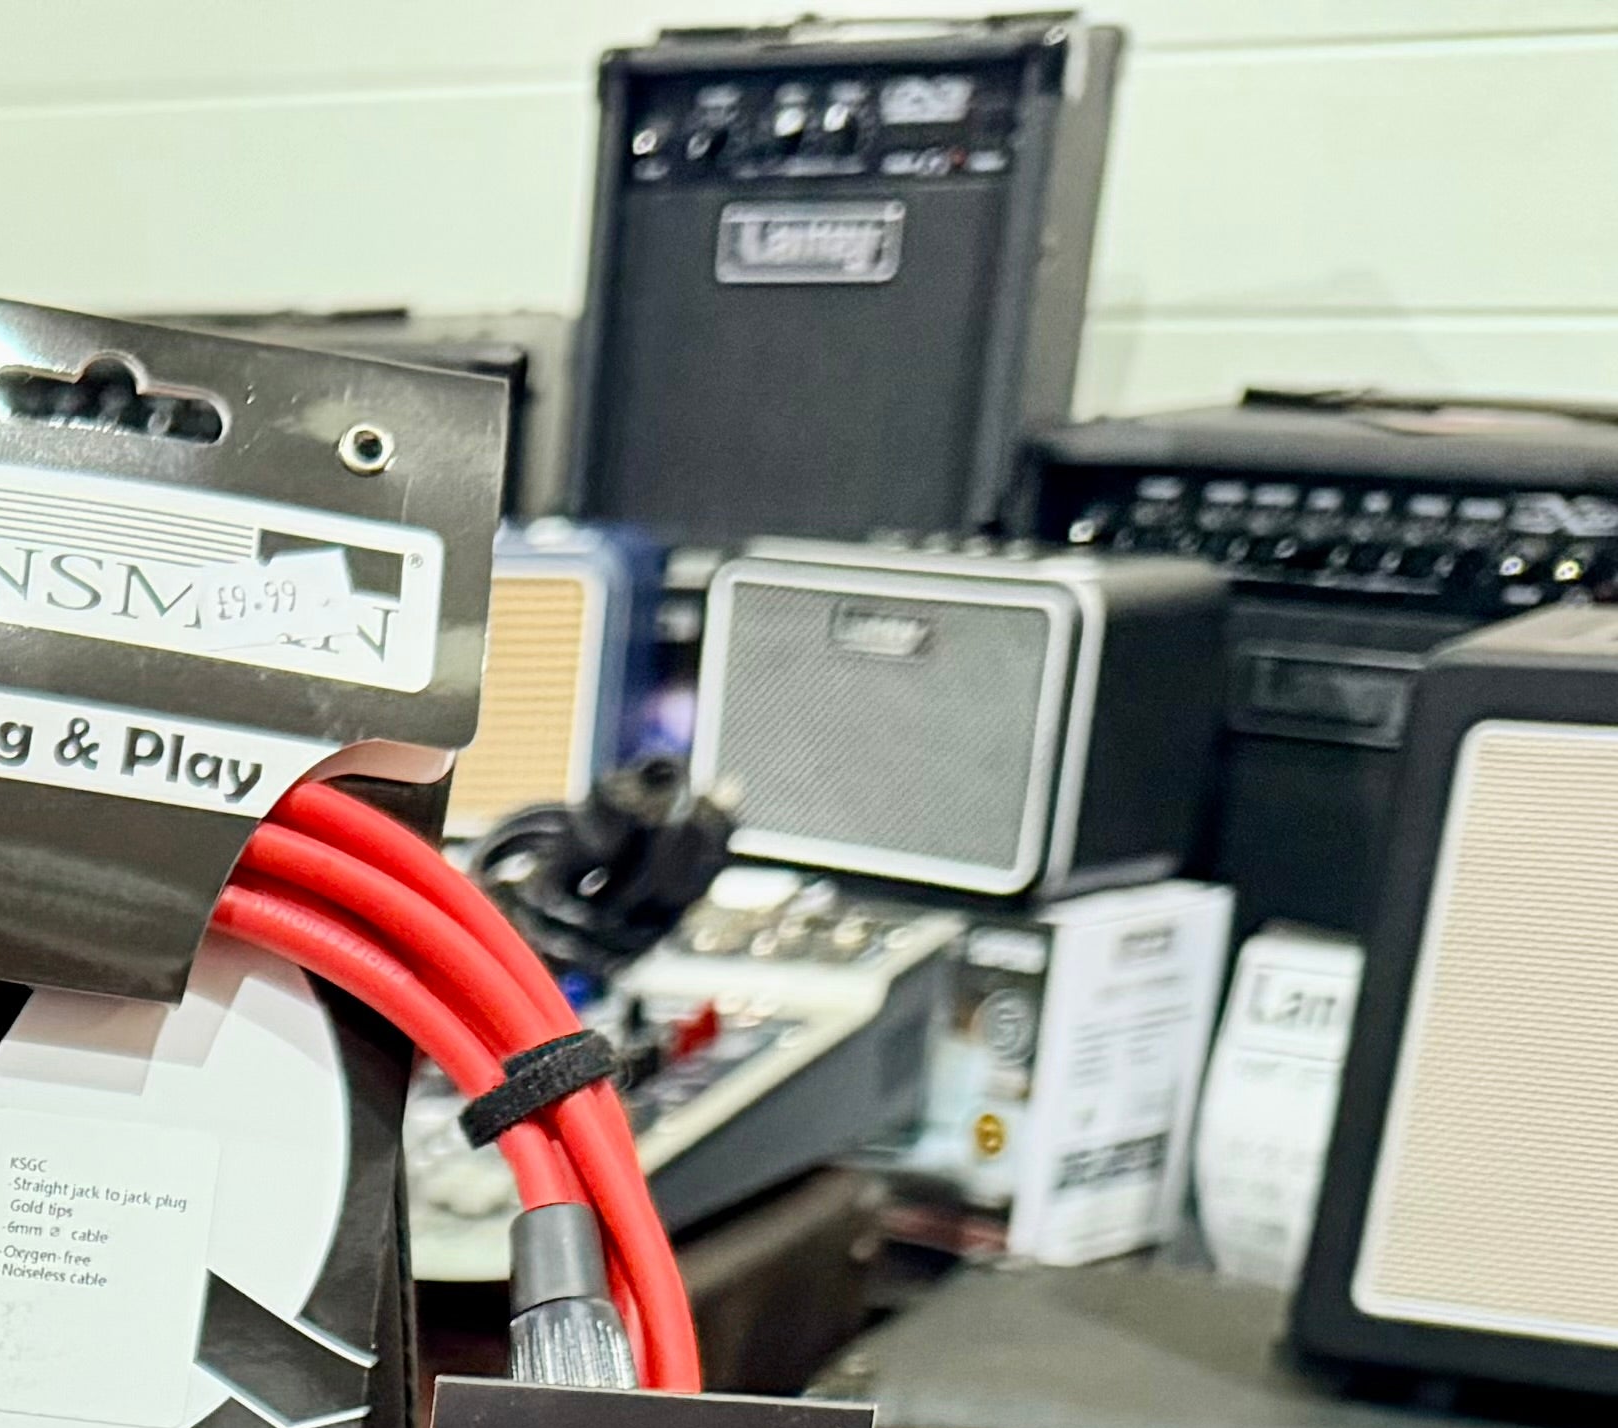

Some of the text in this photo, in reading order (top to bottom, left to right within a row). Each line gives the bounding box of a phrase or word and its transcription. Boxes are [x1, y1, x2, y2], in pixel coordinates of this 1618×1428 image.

[217, 581, 297, 620] £9.99
[53, 718, 100, 771] &
[121, 728, 263, 804] Play
[10, 1157, 48, 1173] KSGC
[69, 1184, 100, 1201] jack
[105, 1188, 120, 1202] to
[121, 1190, 152, 1206] jack
[155, 1194, 188, 1213] plug
[10, 1199, 73, 1219] Gold tips
[70, 1229, 109, 1244] cable
[69, 1272, 108, 1287] cable
